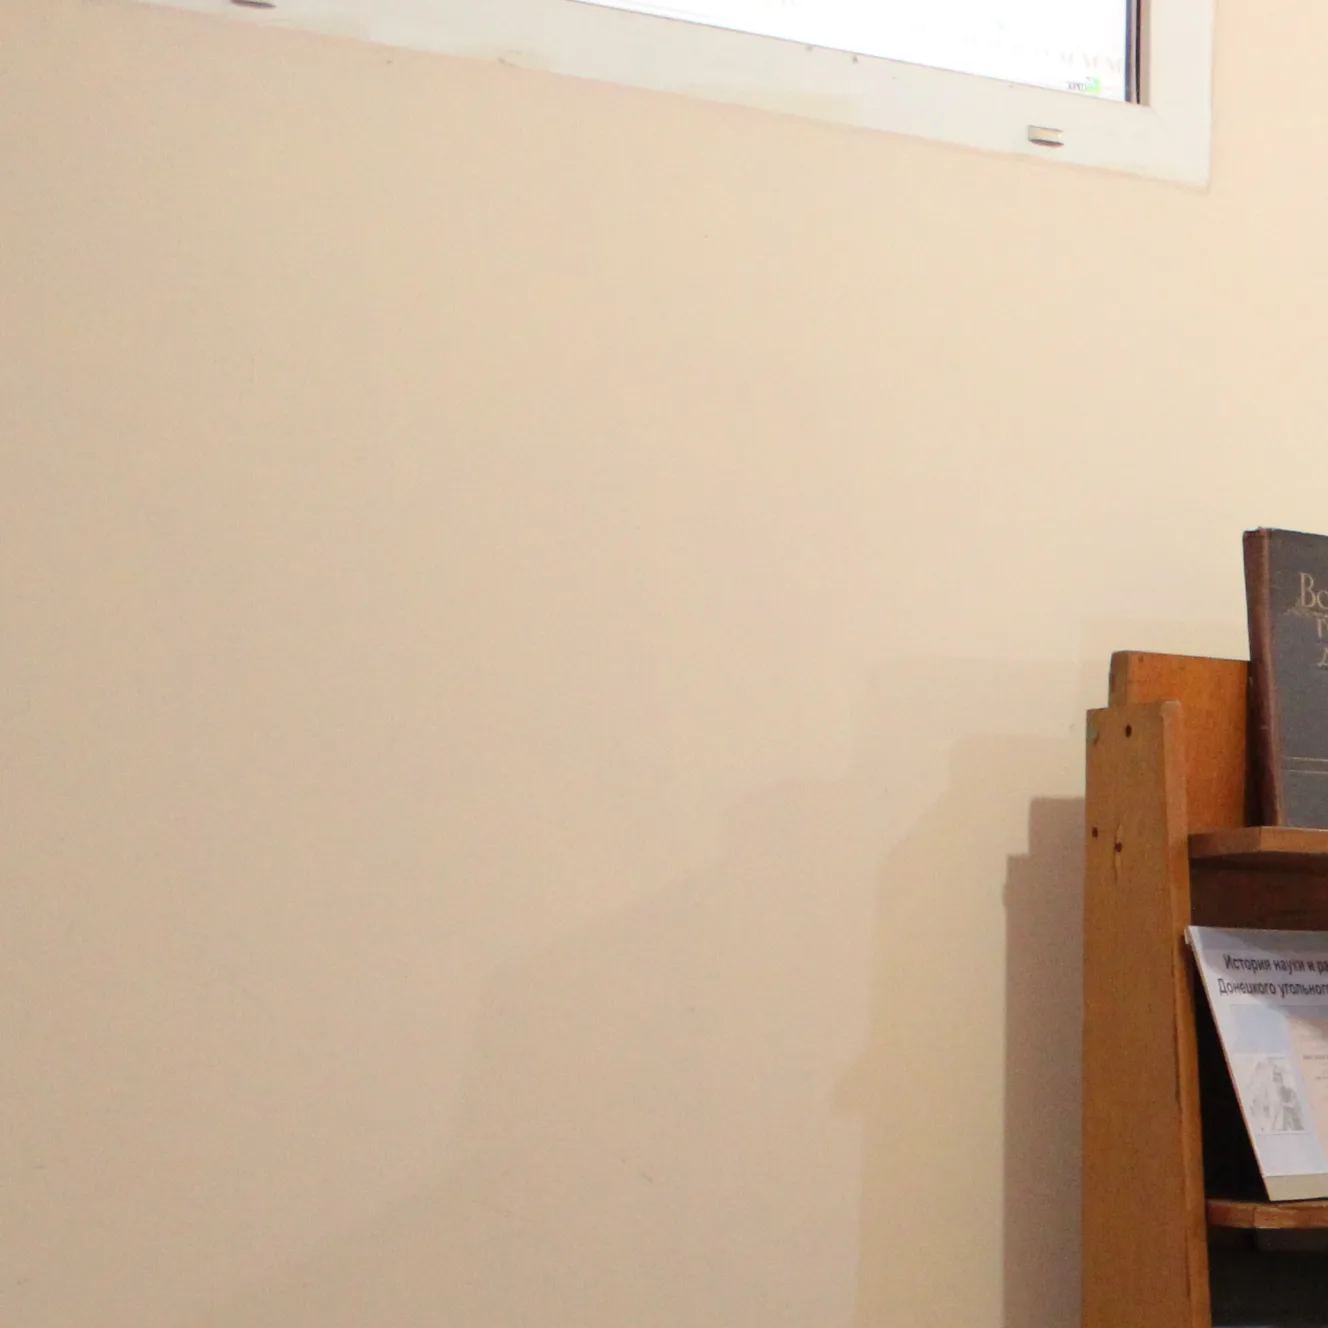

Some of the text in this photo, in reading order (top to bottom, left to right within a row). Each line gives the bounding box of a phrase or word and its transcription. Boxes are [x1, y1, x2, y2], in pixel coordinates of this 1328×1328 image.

[1223, 954, 1271, 973] История
[1275, 958, 1304, 974] науки
[1307, 960, 1314, 971] и
[1217, 978, 1276, 995] Донецкого
